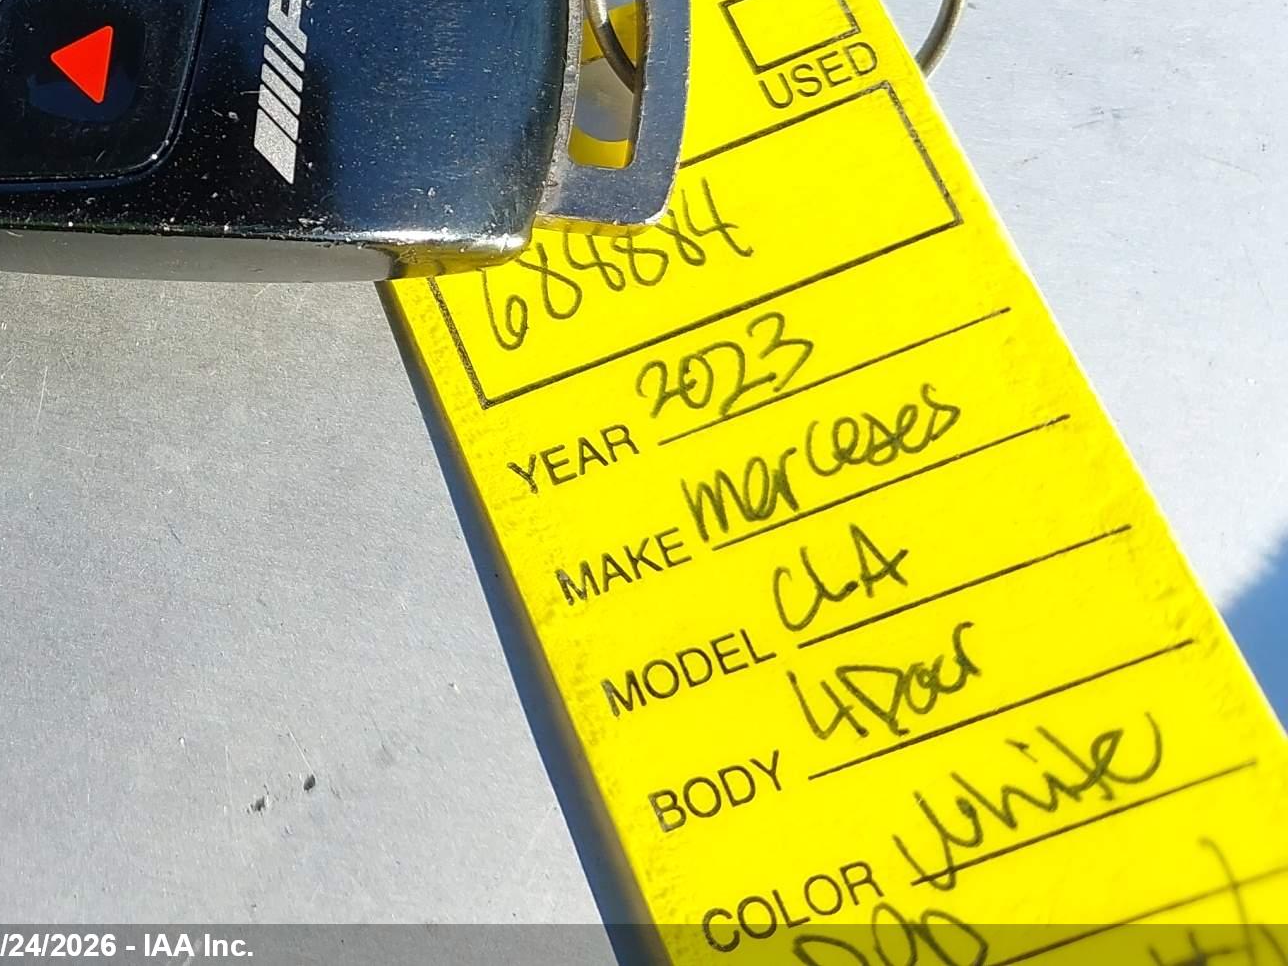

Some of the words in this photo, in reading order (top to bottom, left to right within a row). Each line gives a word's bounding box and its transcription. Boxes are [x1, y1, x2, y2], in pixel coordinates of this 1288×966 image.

[758, 41, 879, 110] USED
[634, 311, 814, 419] 2023
[506, 423, 640, 495] YEAR
[554, 526, 693, 607] MAKE
[773, 522, 910, 632] CLA
[600, 627, 779, 719] MODEL
[647, 749, 783, 834] BODY
[701, 860, 886, 953] COLOR
